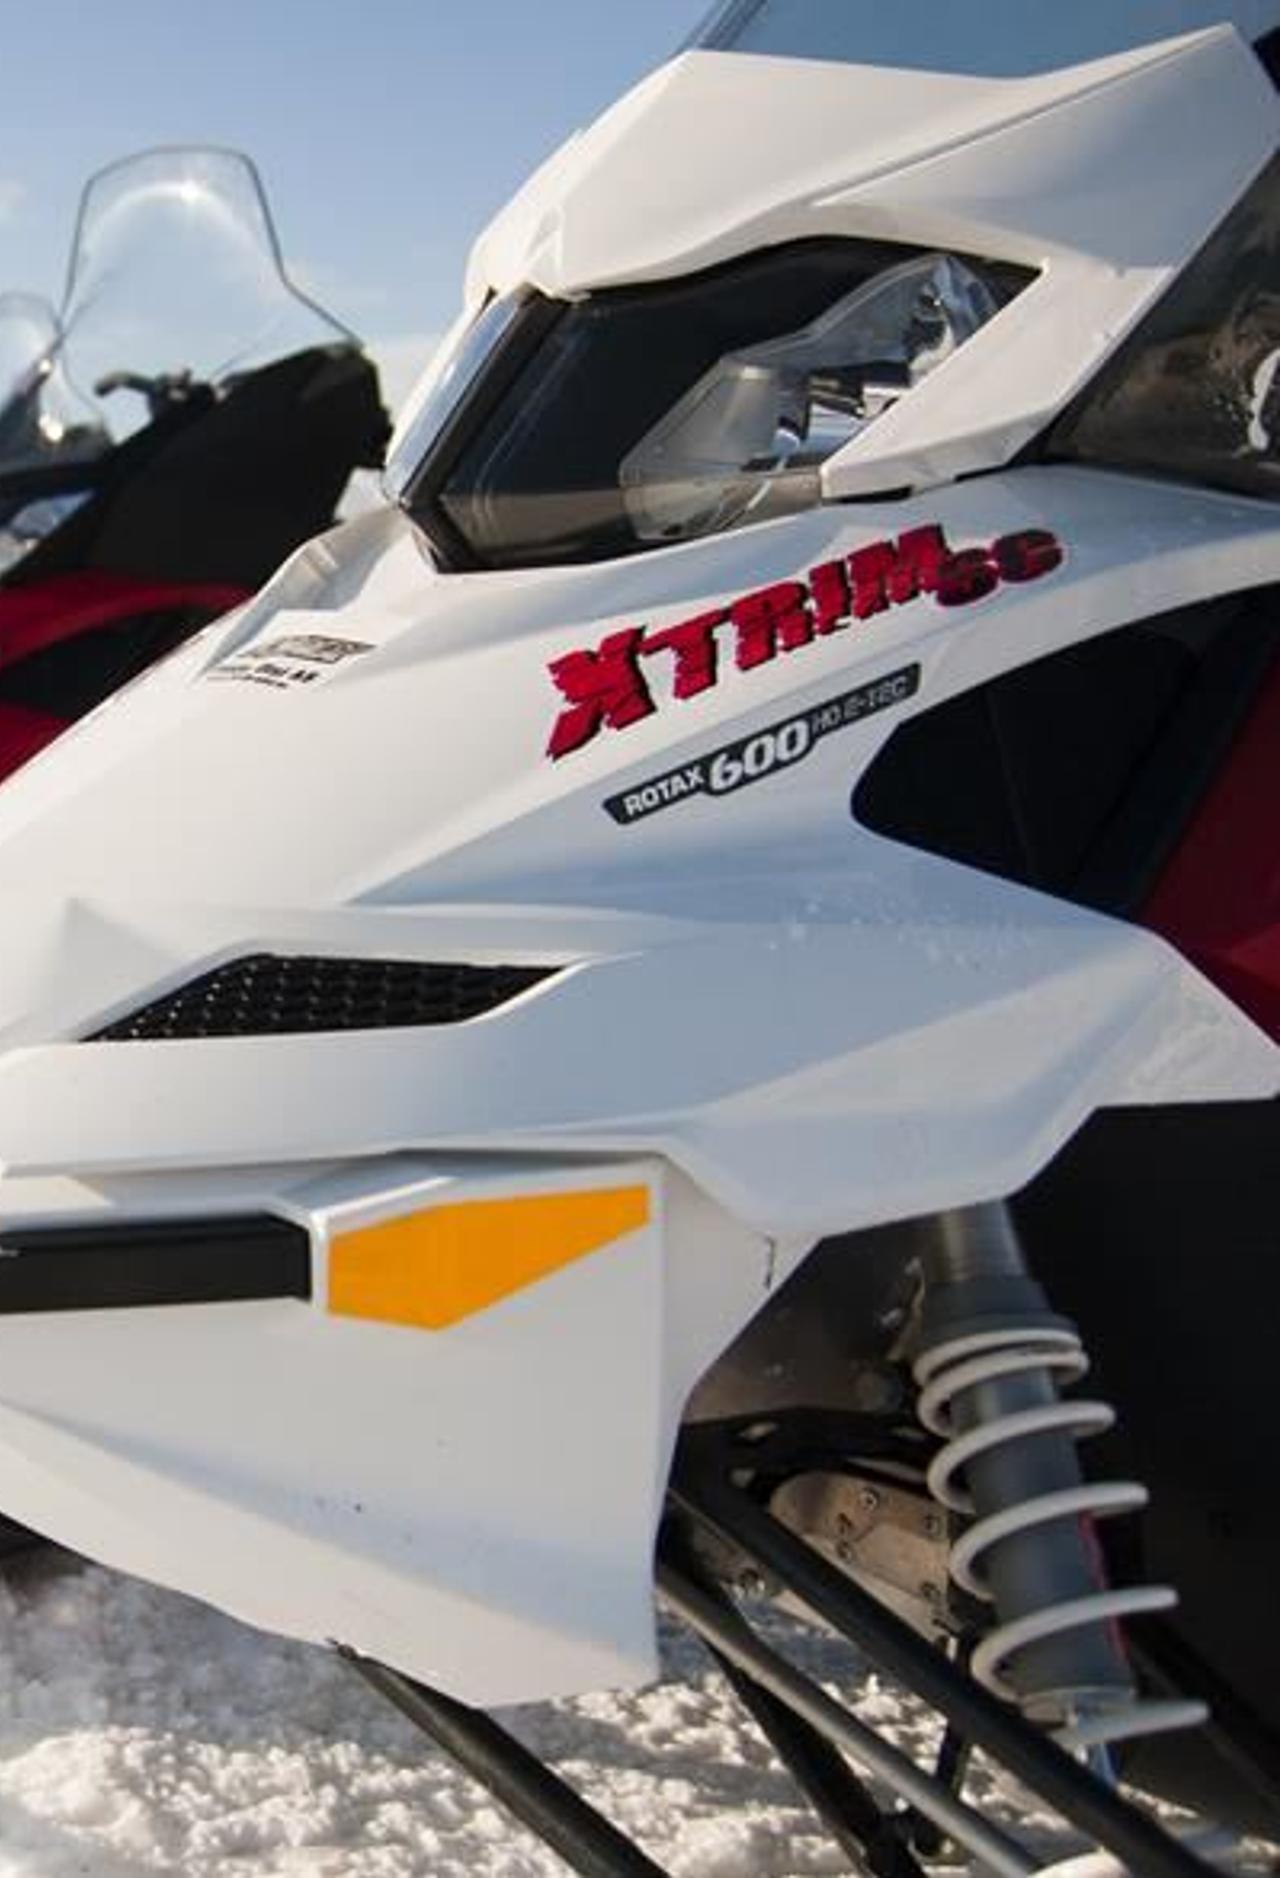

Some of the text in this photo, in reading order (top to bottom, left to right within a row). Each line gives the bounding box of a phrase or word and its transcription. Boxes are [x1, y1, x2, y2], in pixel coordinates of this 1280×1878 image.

[546, 524, 944, 760] XTRIM
[622, 765, 704, 816] ROTAX
[709, 720, 810, 790] 600
